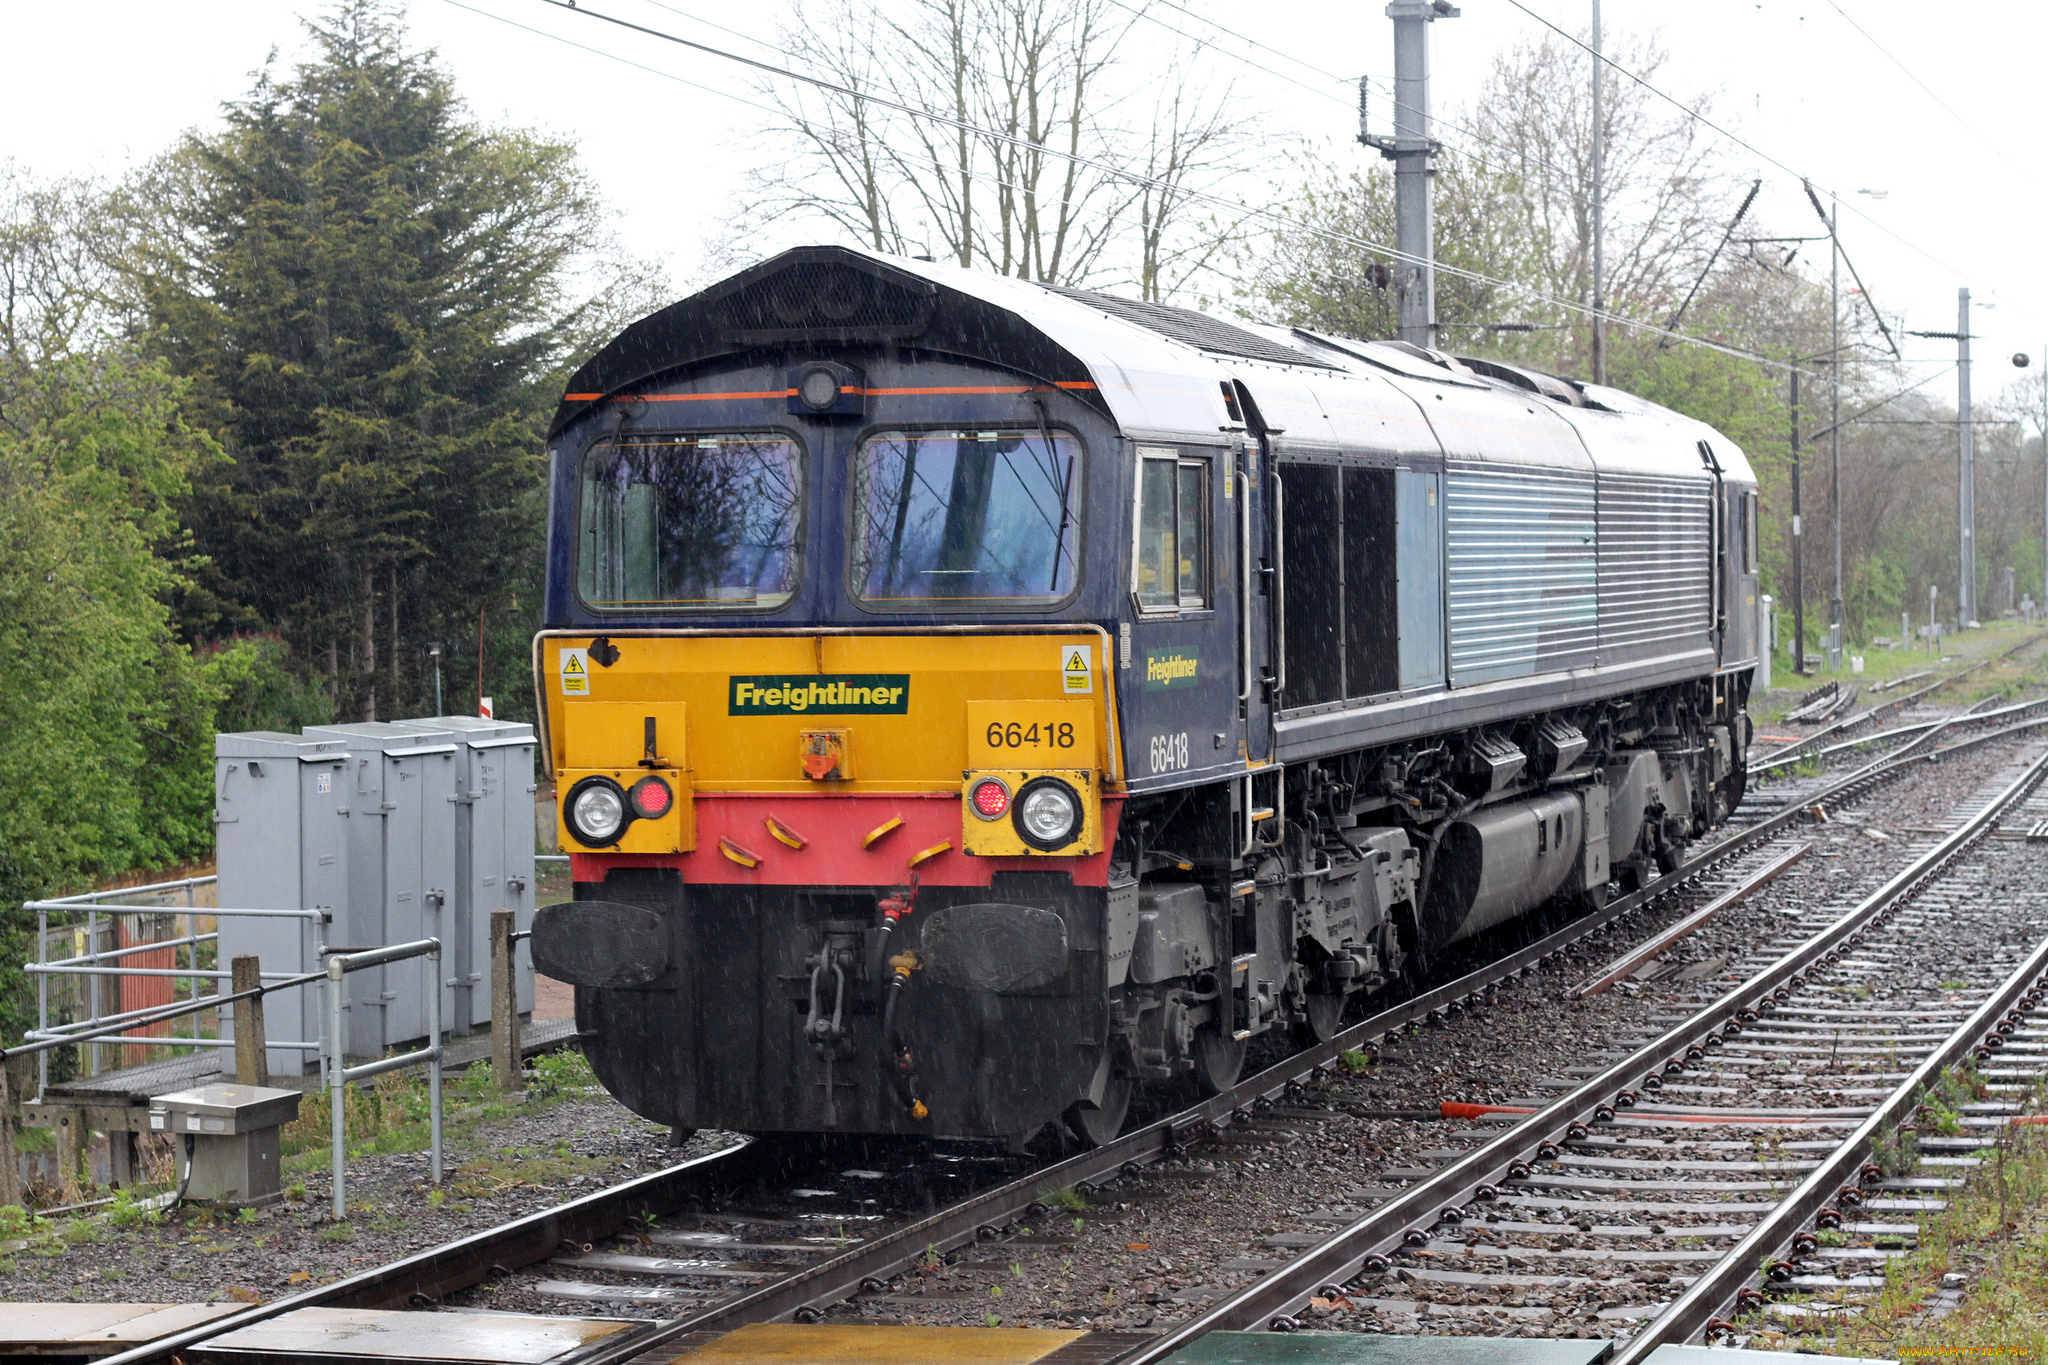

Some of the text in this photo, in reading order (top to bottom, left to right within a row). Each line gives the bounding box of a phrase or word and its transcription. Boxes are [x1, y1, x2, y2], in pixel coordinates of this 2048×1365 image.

[1147, 654, 1198, 686] Freightliner
[735, 681, 903, 712] Freightliner
[986, 721, 1075, 749] 66418
[1150, 732, 1189, 774] 66418
